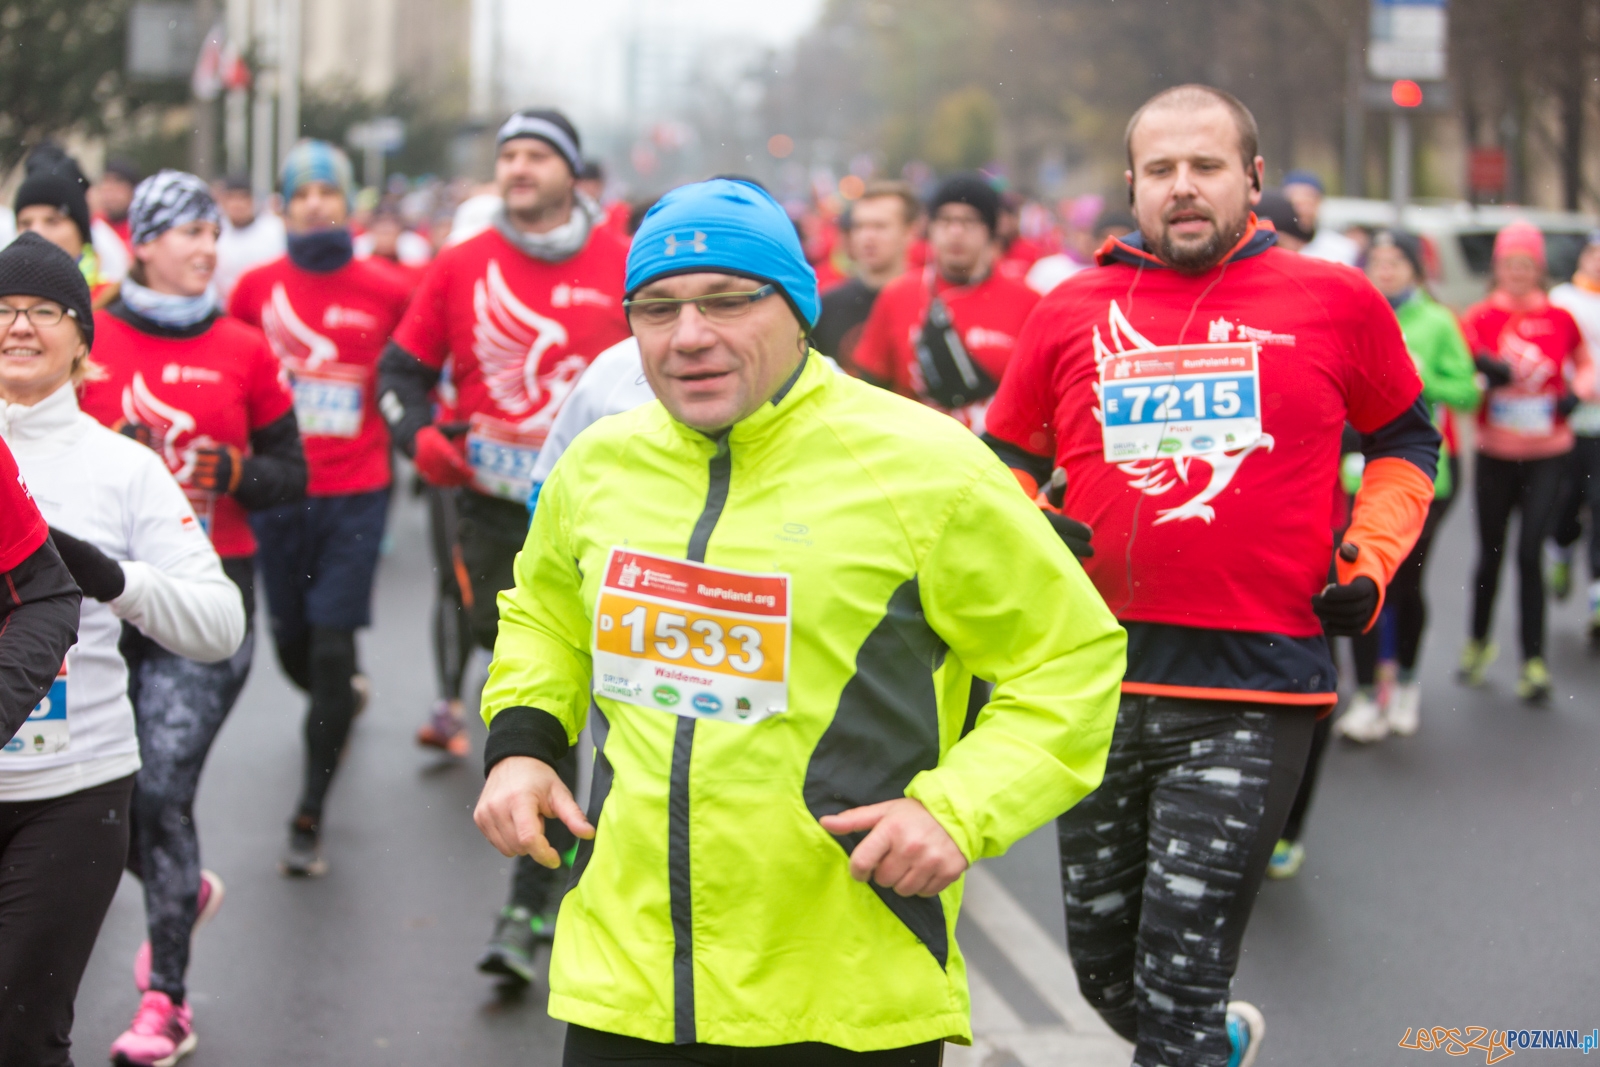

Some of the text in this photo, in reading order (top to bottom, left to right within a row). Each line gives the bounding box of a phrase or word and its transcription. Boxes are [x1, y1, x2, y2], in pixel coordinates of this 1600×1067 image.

[1183, 357, 1246, 369] RunPoland.org
[1106, 381, 1241, 422] E 7215
[697, 584, 776, 607] RunPoland.org
[600, 605, 765, 674] D 1533
[654, 666, 713, 686] Waldemar
